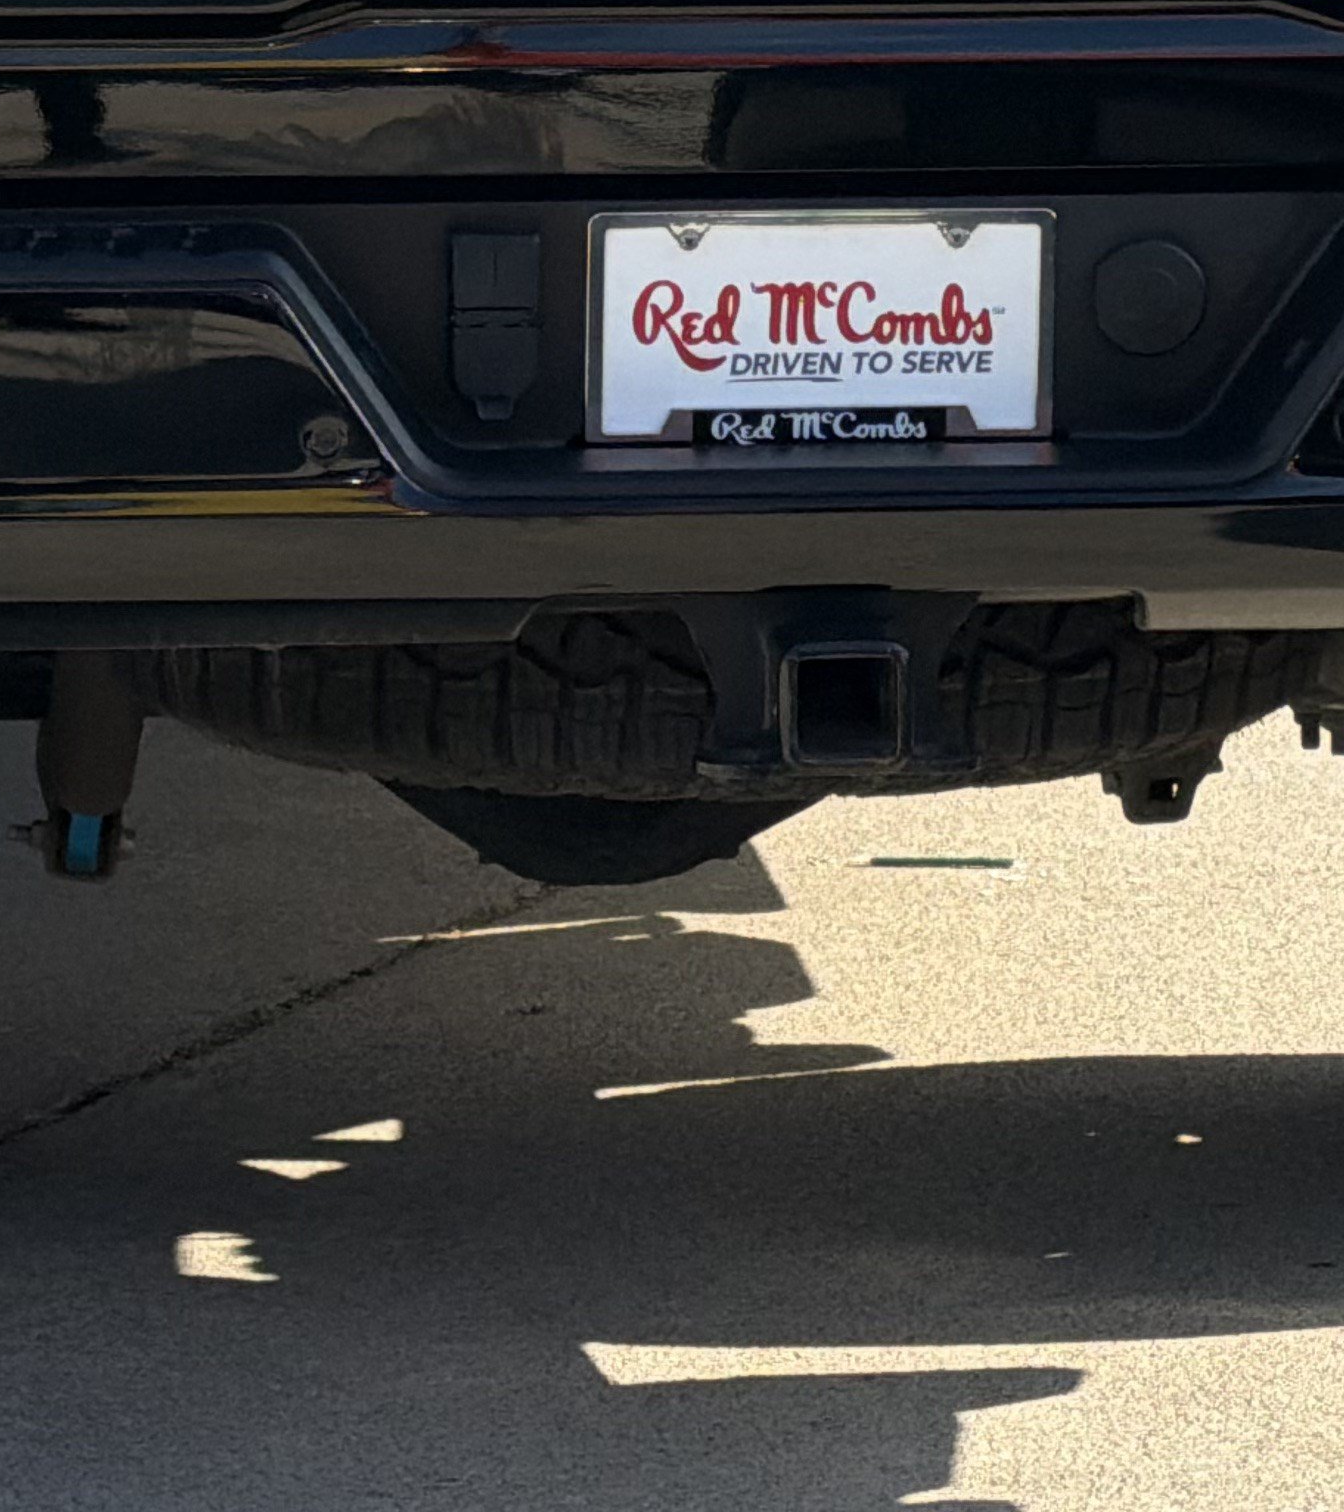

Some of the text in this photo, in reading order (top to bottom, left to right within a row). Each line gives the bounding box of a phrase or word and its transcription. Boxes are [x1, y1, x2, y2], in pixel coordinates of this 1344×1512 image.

[631, 279, 993, 372] Red McCombs
[729, 350, 994, 376] DRIVEN TO SERVE
[710, 410, 928, 445] Red McCombs
